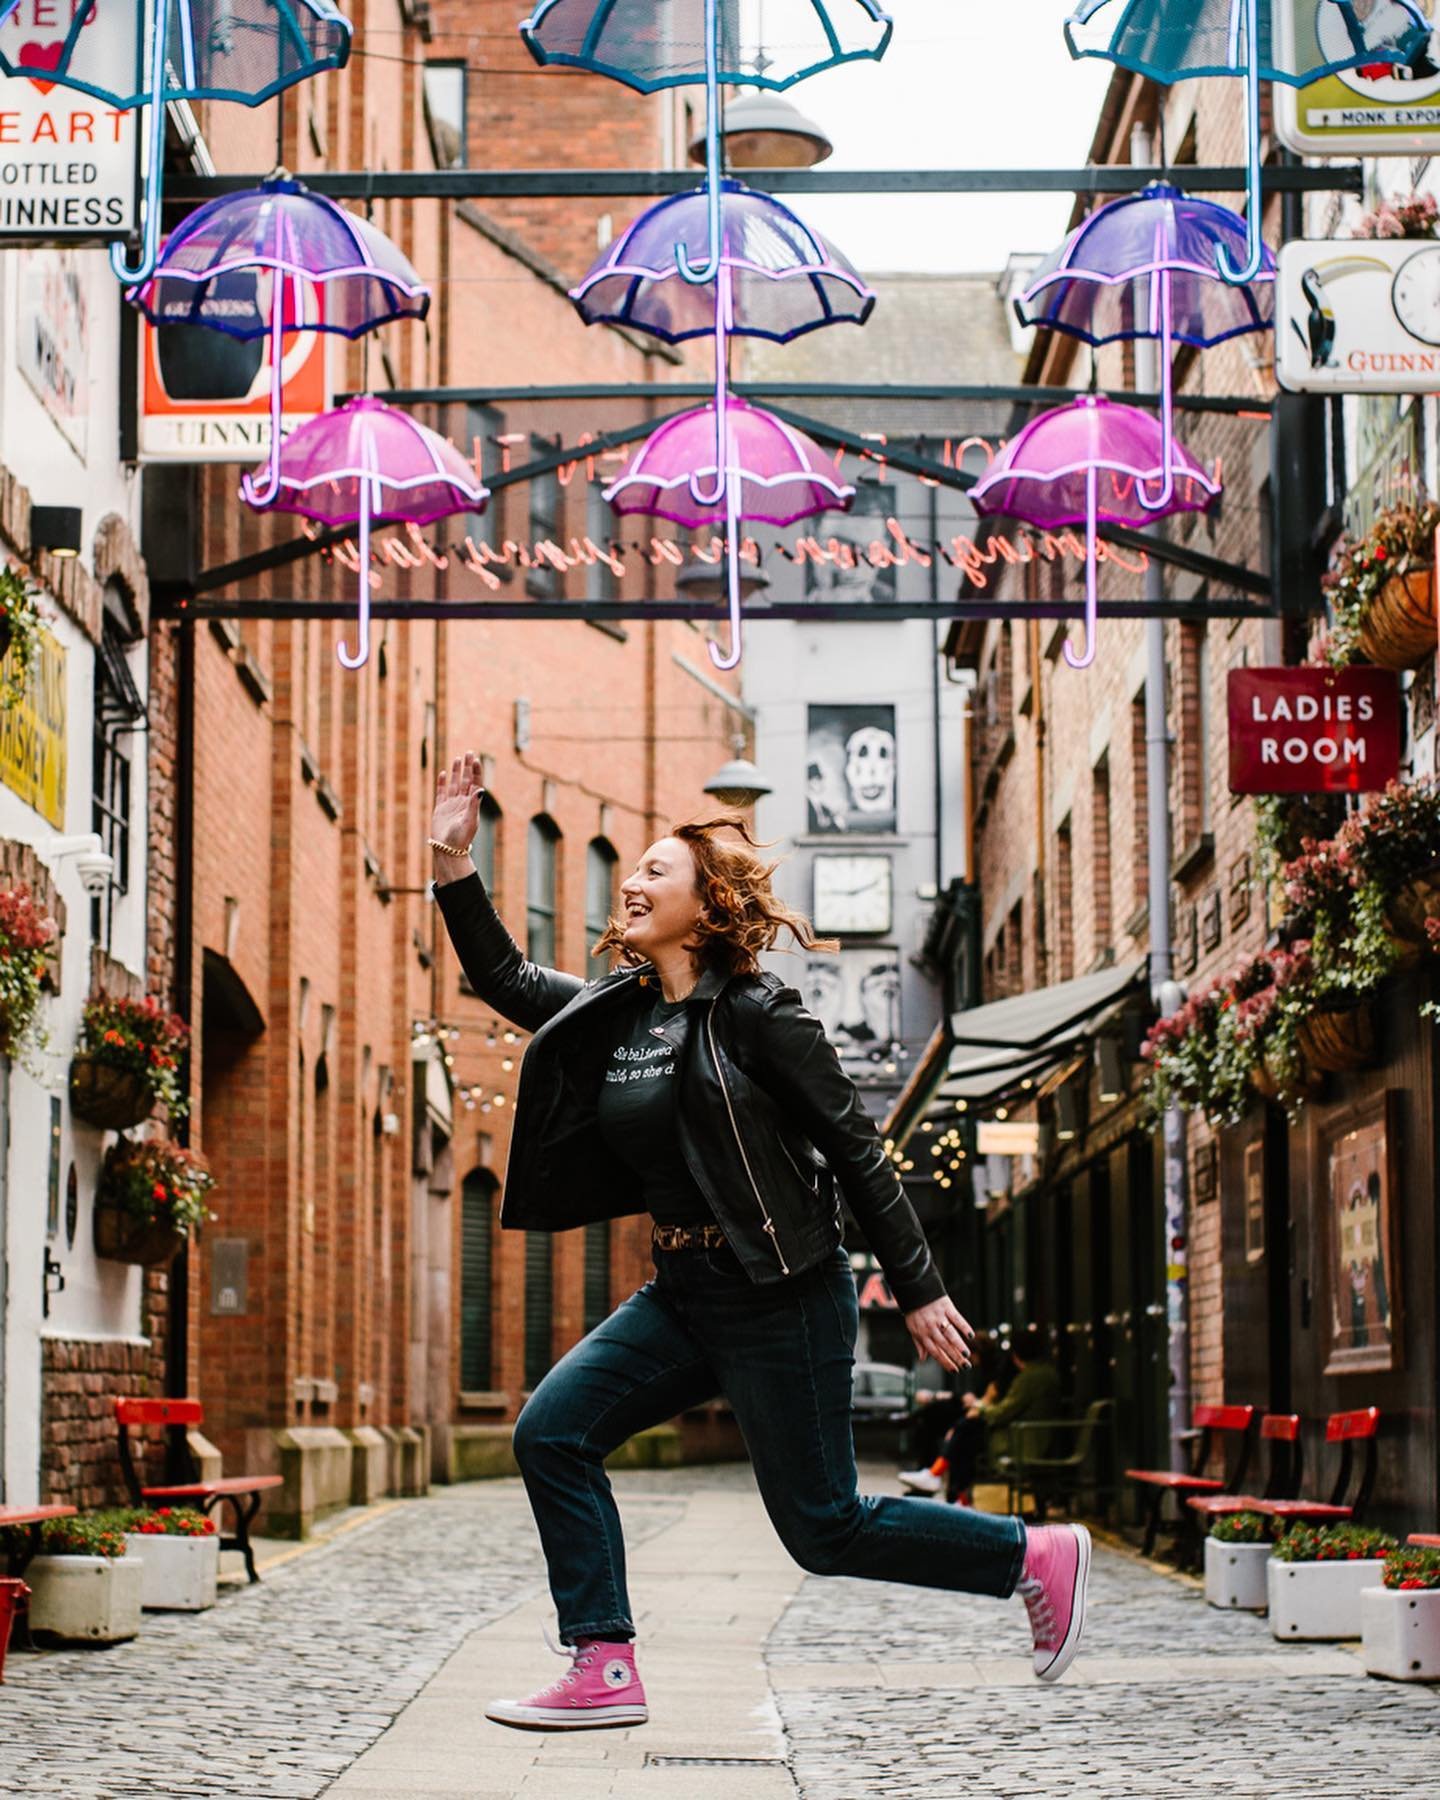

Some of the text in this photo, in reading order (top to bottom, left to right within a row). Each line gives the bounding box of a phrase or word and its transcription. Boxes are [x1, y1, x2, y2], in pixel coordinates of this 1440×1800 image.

[1342, 110, 1386, 124] MONK
[1252, 695, 1374, 721] LADIES
[1261, 737, 1367, 764] ROOM
[628, 1069, 641, 1081] so
[642, 1064, 663, 1078] she
